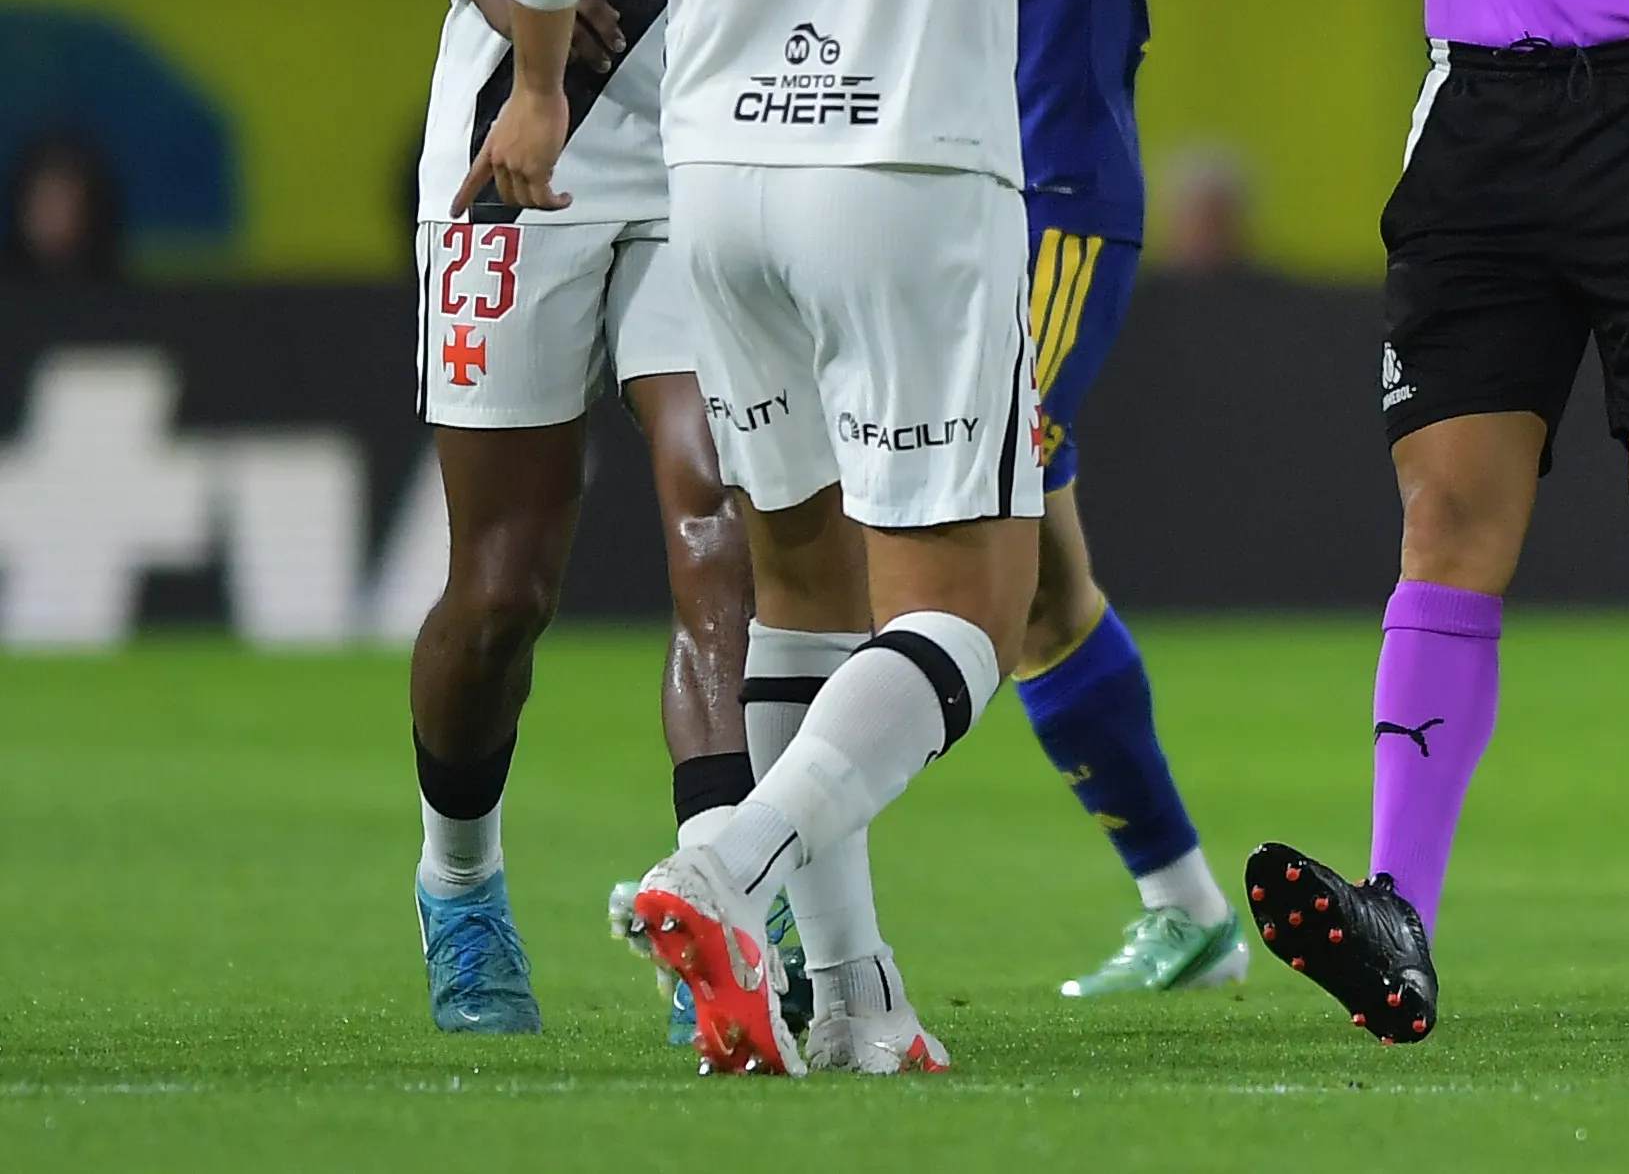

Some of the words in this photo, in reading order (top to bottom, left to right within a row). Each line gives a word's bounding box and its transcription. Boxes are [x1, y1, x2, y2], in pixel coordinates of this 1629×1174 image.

[780, 74, 836, 88] MOTO
[733, 91, 881, 125] CHEFE
[440, 222, 522, 320] 23
[862, 417, 979, 451] FACILITY
